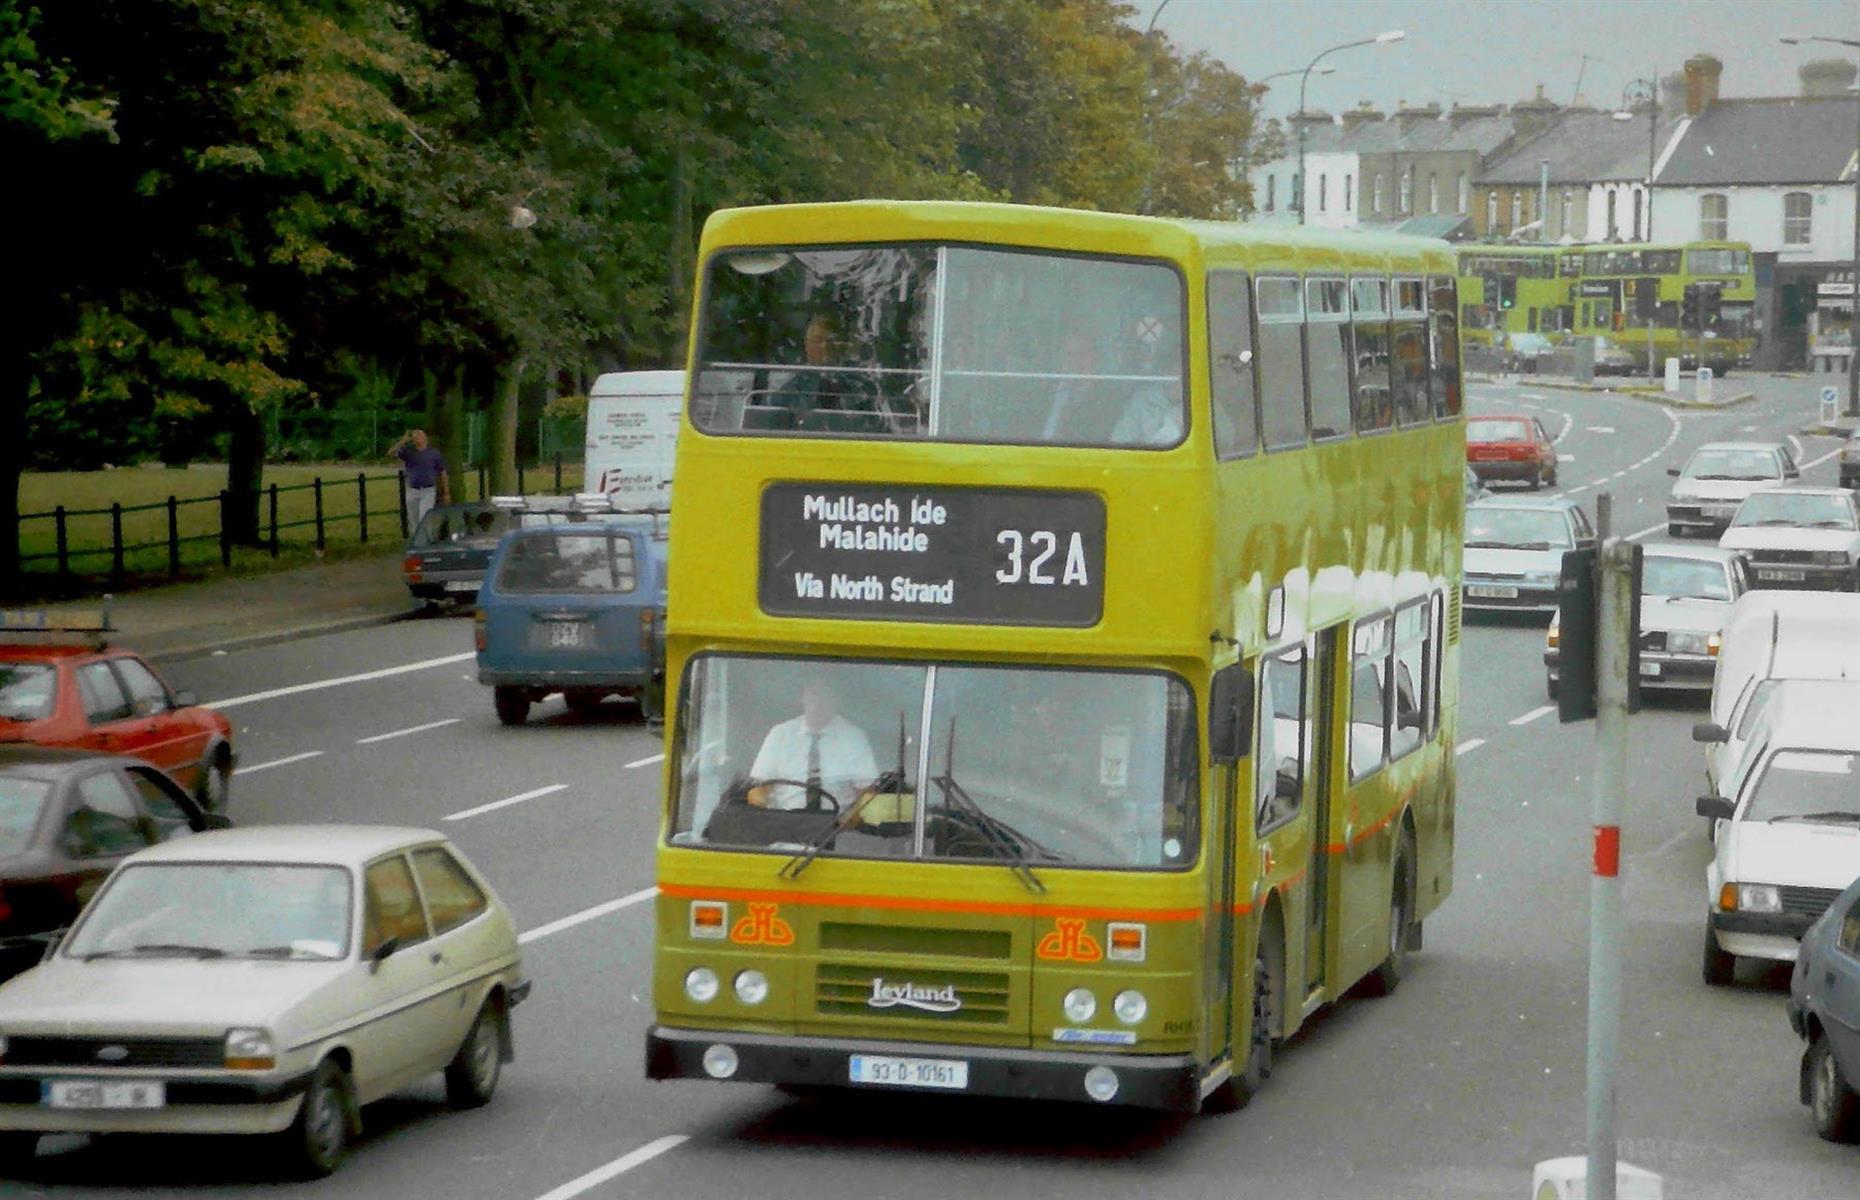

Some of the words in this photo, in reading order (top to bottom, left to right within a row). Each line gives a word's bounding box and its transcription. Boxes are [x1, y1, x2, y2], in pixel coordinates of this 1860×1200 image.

[803, 494, 900, 523] Mullach
[819, 523, 930, 552] Malahide
[996, 529, 1089, 586] 32A
[794, 572, 824, 599] Via
[830, 573, 884, 601] North
[890, 575, 955, 605] Strand
[869, 977, 960, 1009] Leyland
